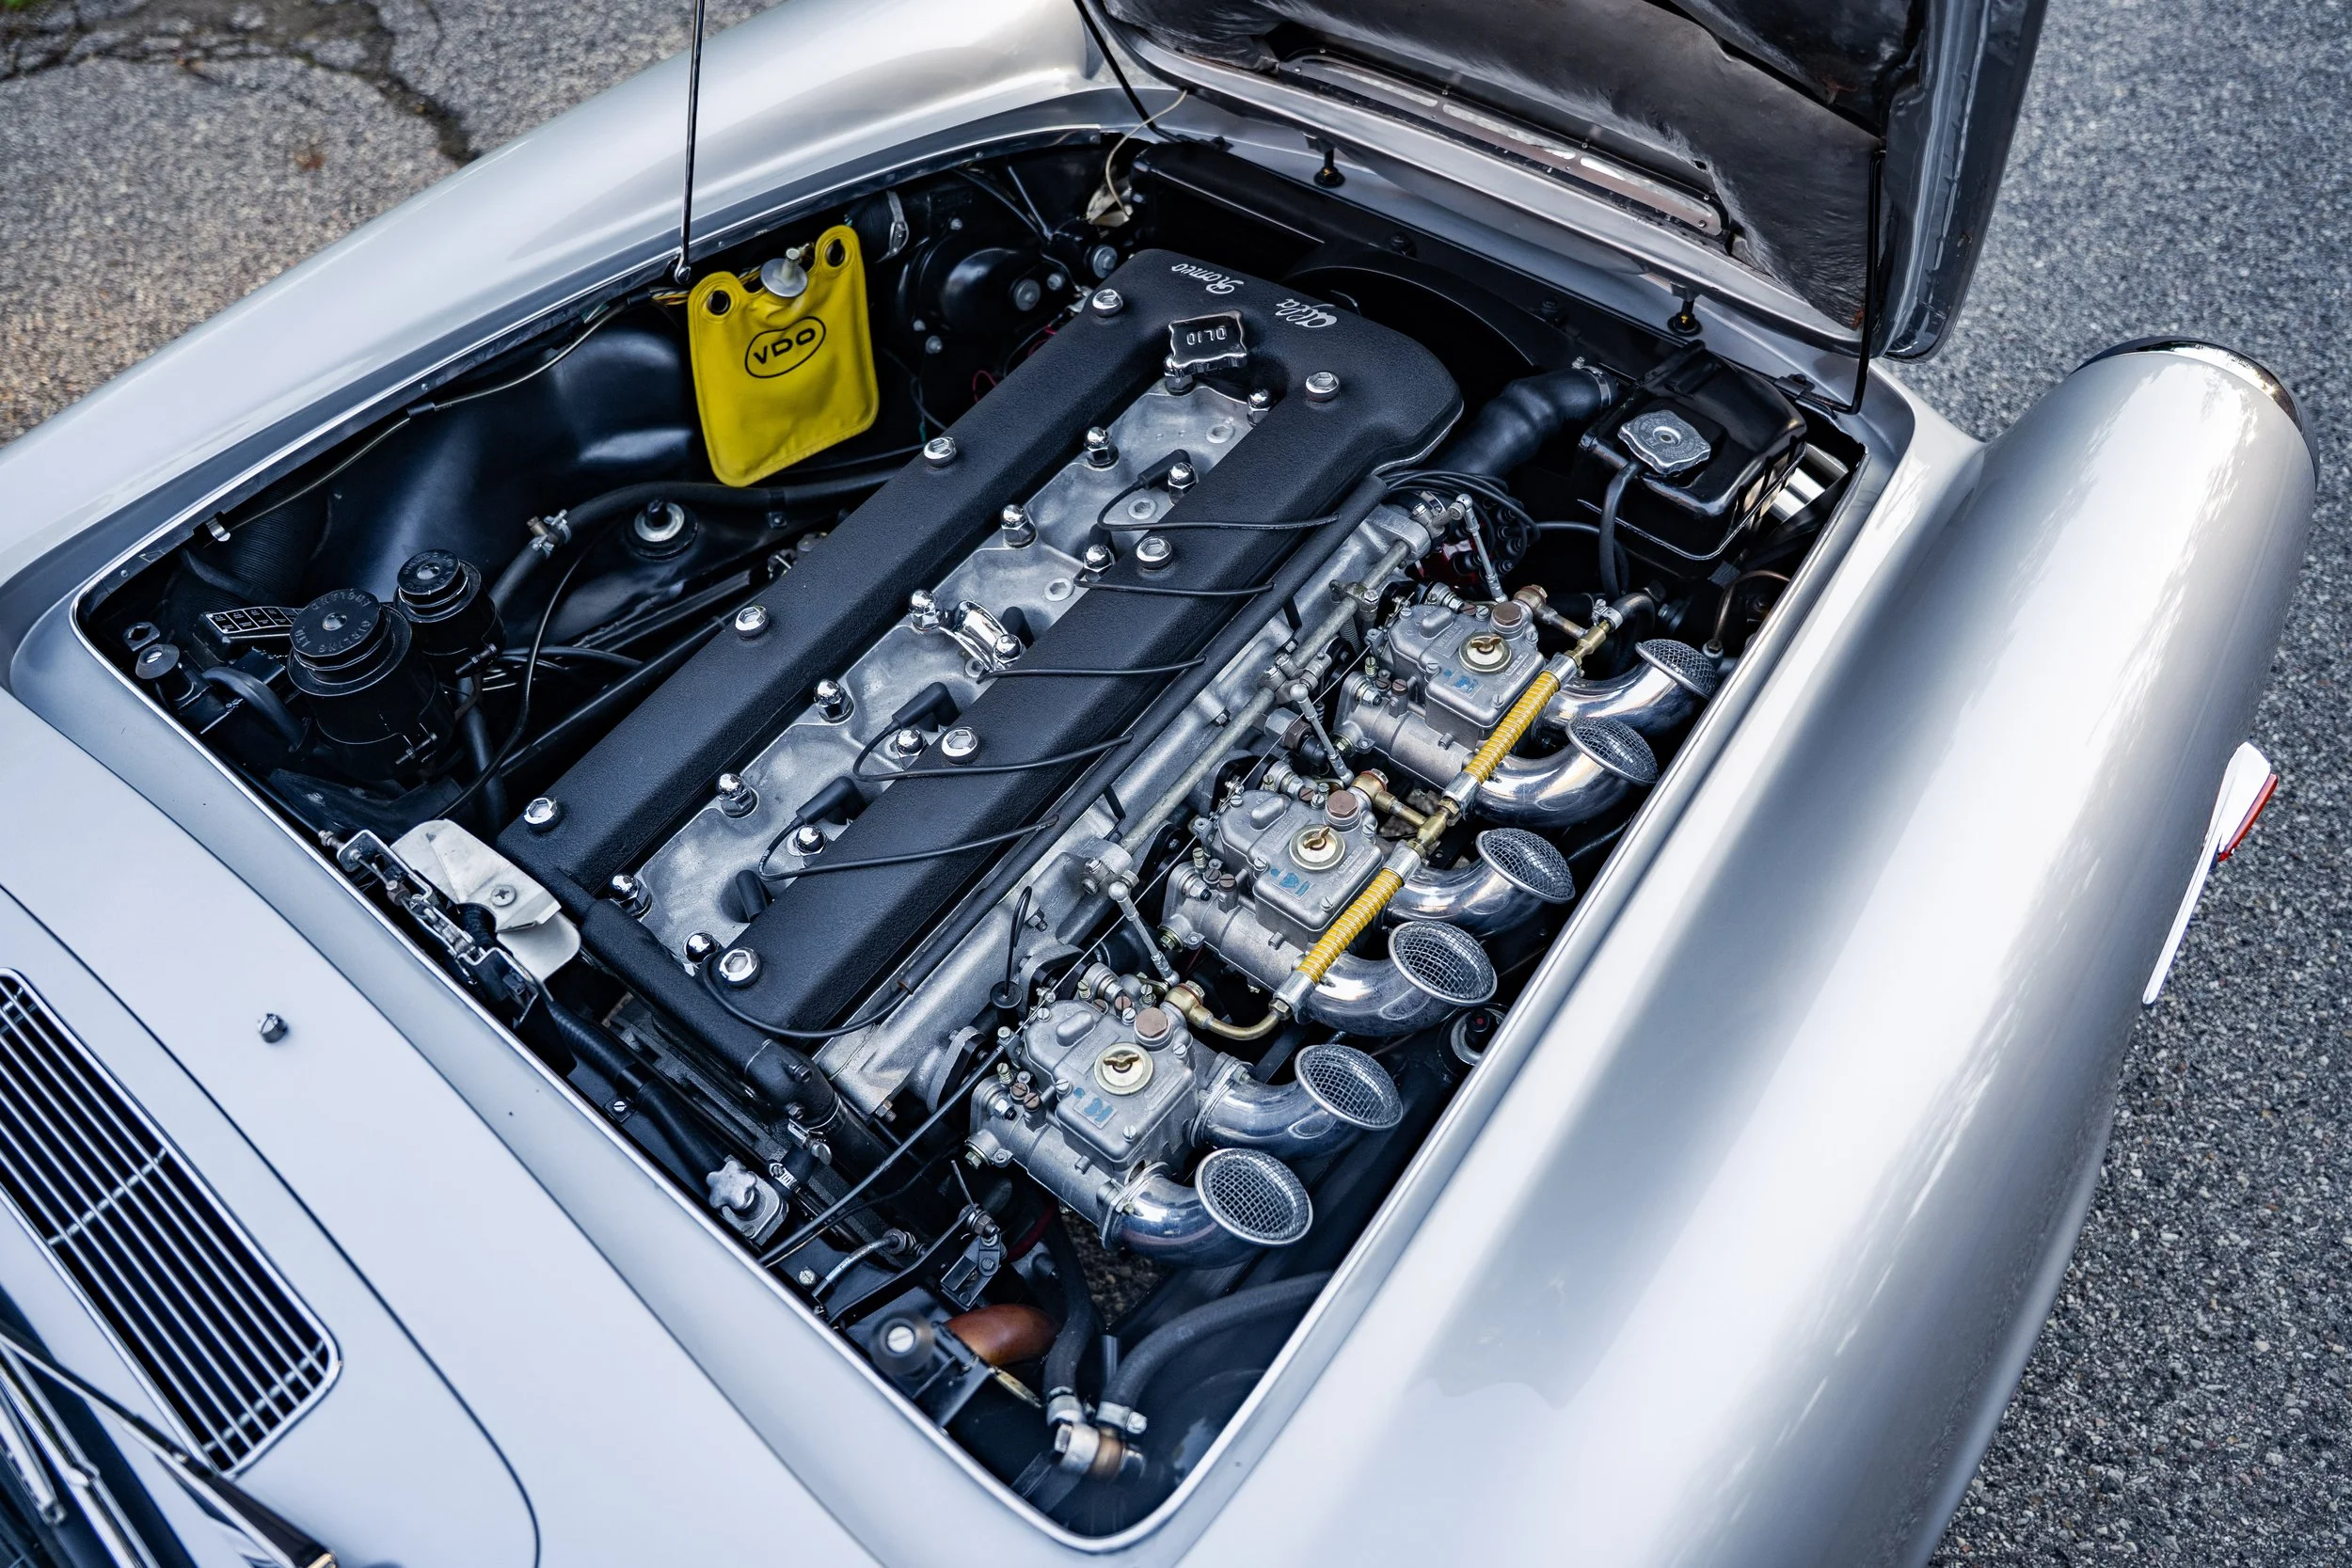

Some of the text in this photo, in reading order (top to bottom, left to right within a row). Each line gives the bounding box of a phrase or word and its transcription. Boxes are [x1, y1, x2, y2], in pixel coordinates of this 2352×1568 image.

[1171, 263, 1337, 328] Alfa Romeo
[753, 328, 816, 365] VDO
[1186, 325, 1227, 345] OLIO
